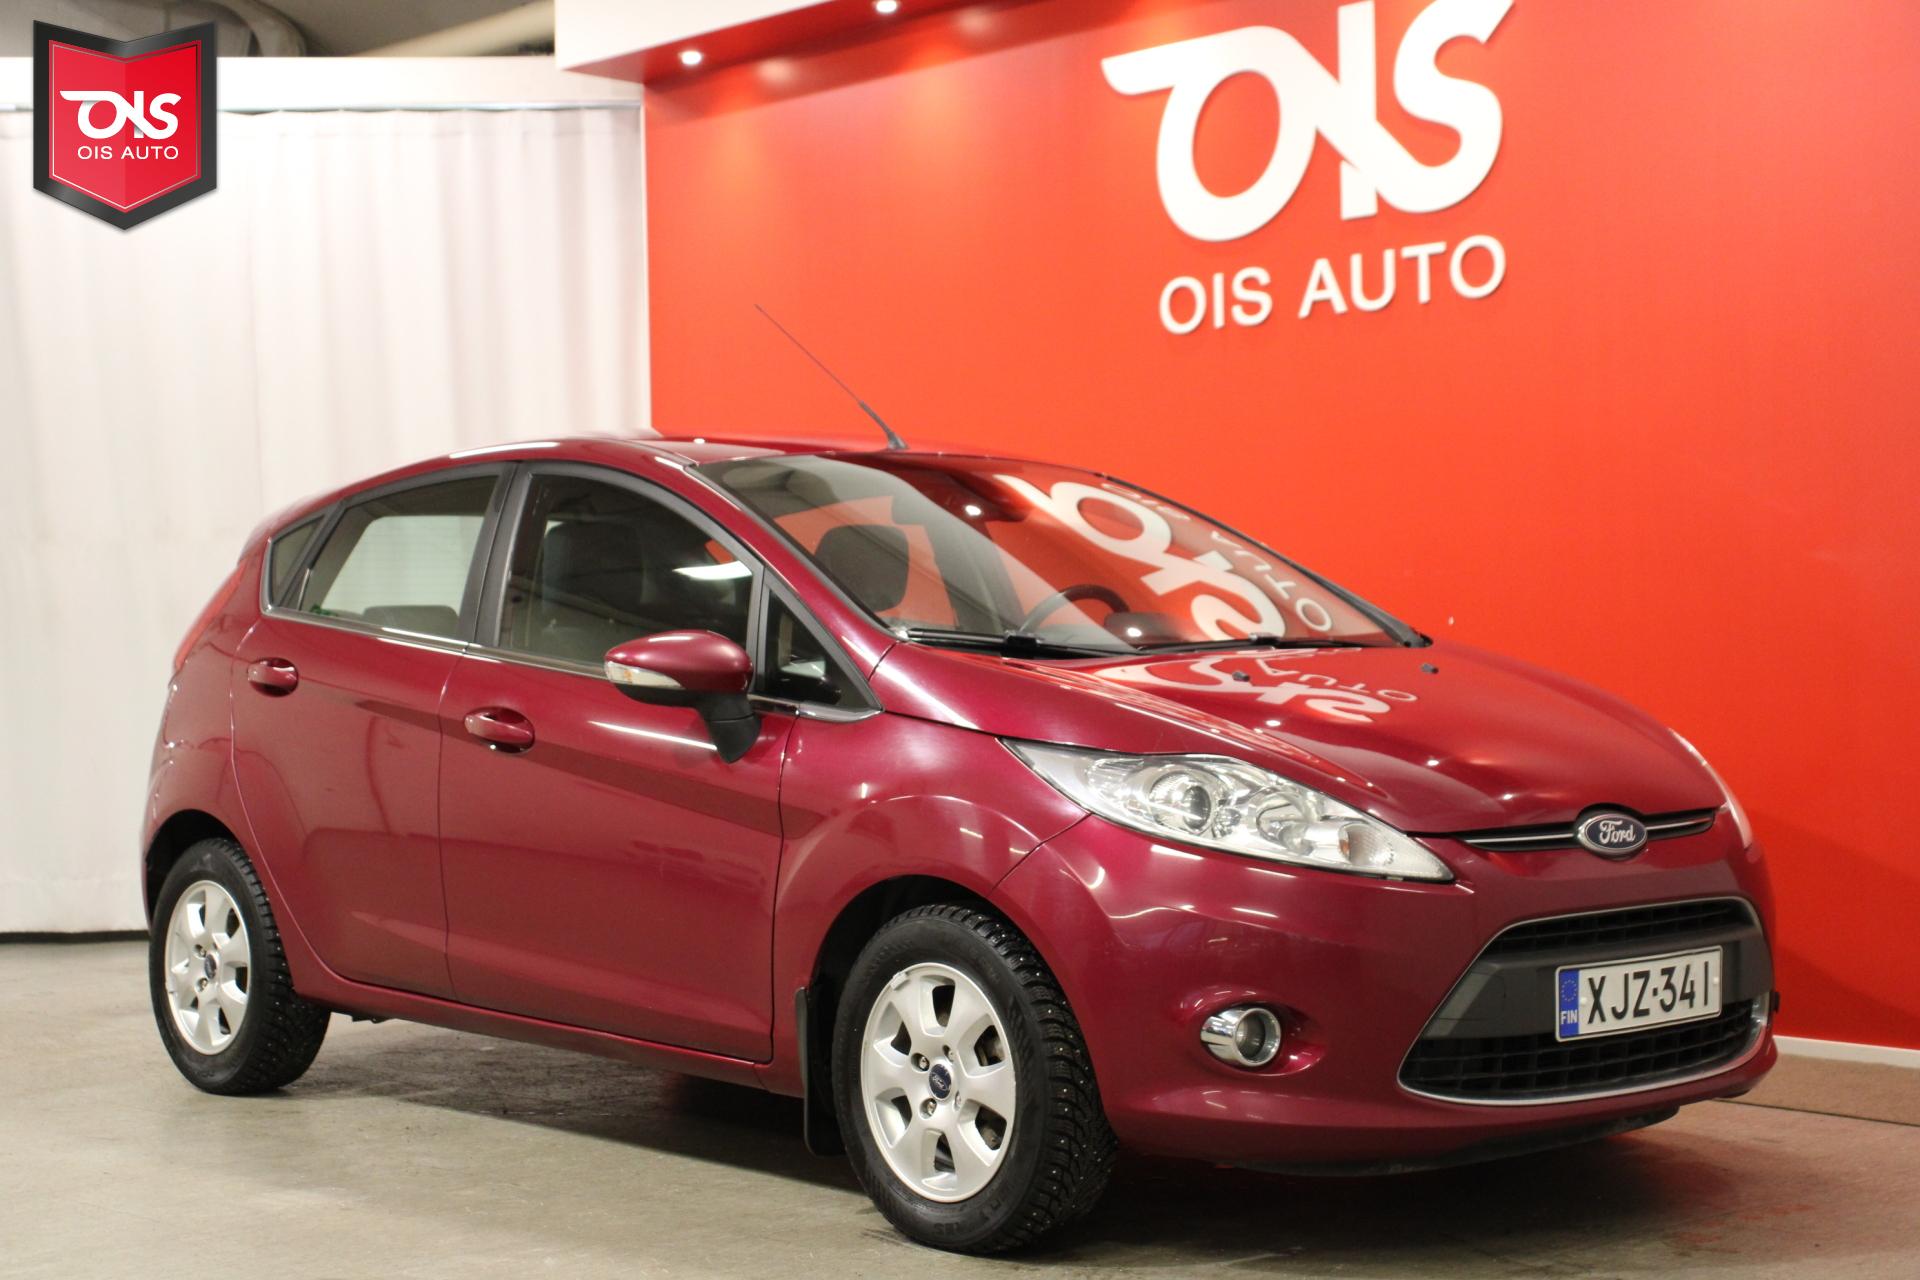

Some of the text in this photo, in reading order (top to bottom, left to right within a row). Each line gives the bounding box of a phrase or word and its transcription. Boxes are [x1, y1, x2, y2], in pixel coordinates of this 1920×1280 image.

[1101, 0, 1516, 242] OIS
[1158, 234, 1507, 335] OIS AUTO
[1599, 819, 1637, 845] Ford
[1560, 1009, 1579, 1026] FIN
[1587, 961, 1710, 1025] XJZ-341
